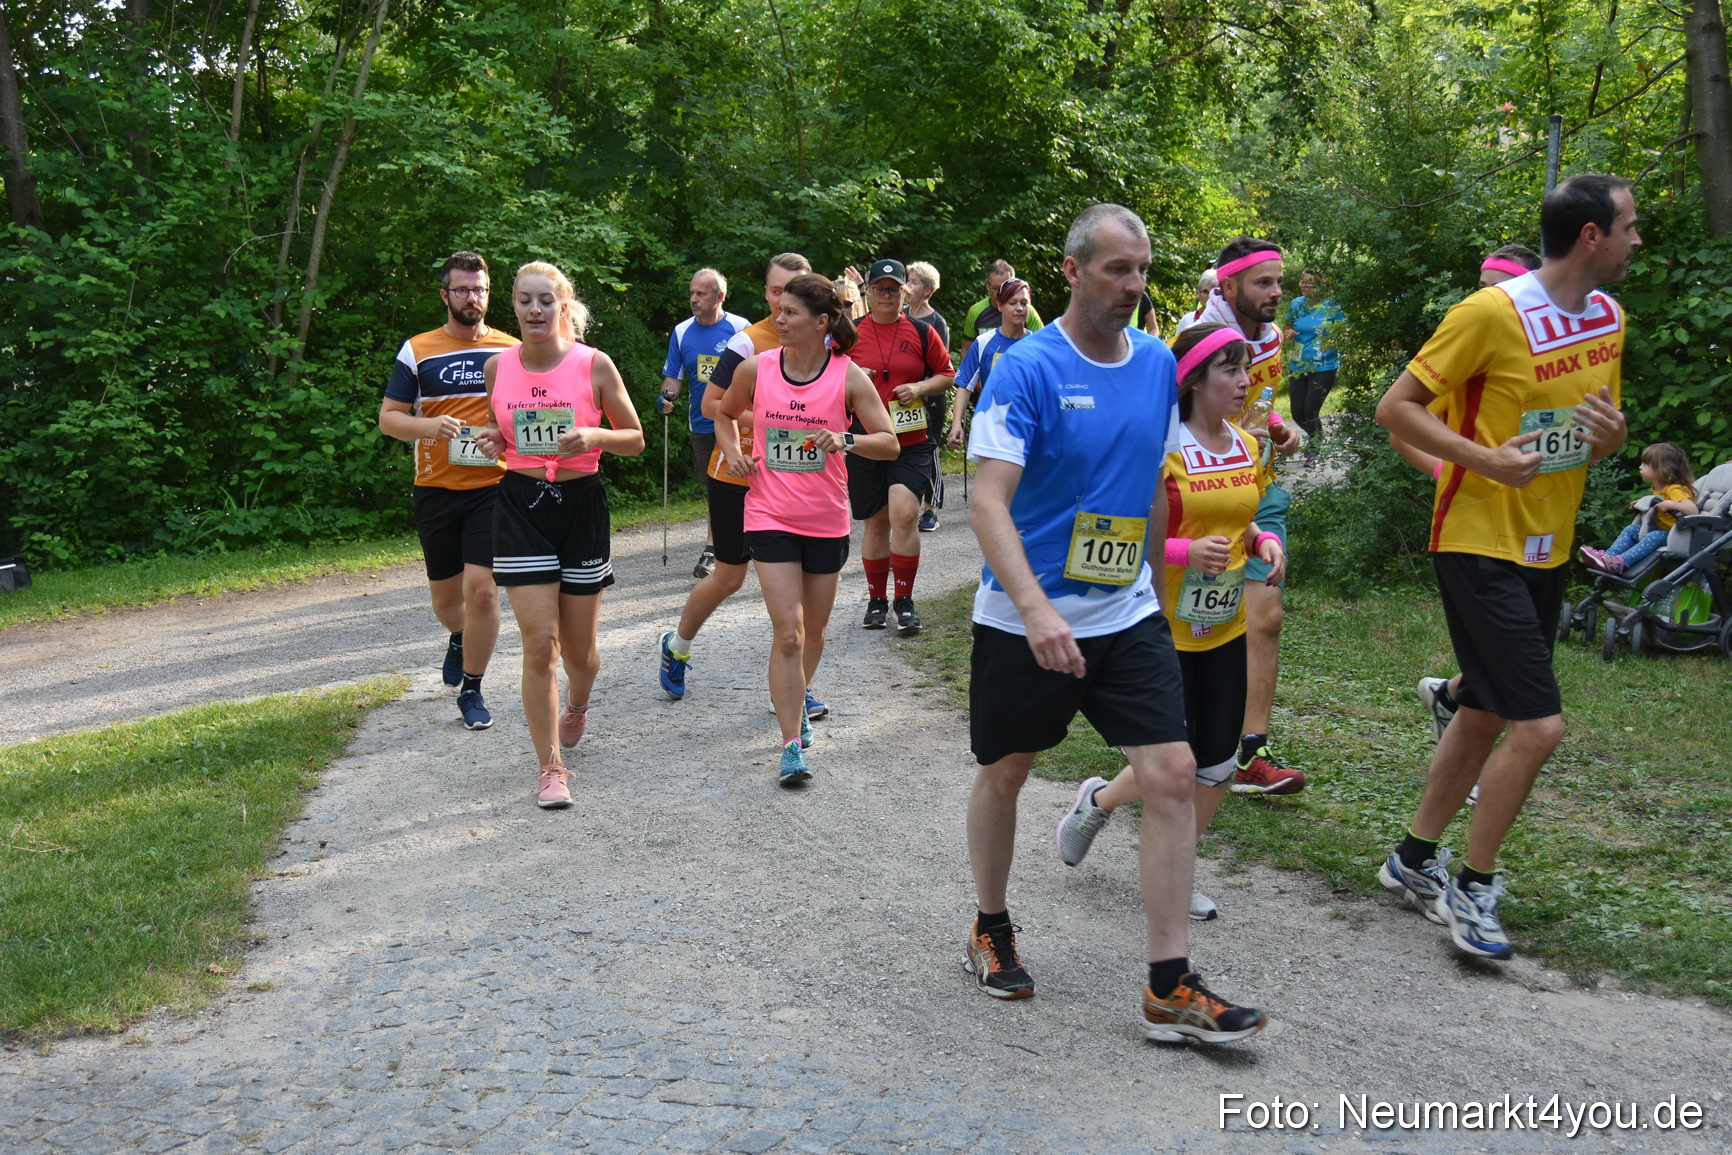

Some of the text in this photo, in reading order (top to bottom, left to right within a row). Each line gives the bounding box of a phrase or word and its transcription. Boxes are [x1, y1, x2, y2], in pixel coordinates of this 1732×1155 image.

[1534, 341, 1621, 383] MAX BÖG
[531, 387, 547, 398] Die
[507, 401, 572, 410] Kieferorthopäden
[790, 400, 806, 411] Die
[765, 411, 829, 426] Kieferorthopäden
[896, 408, 923, 424] 2351
[773, 443, 818, 461] 1118
[1189, 472, 1258, 493] MAX BÖG
[1083, 539, 1137, 566] 1070
[1081, 562, 1116, 573] Guthmann
[1191, 587, 1239, 610] 1642
